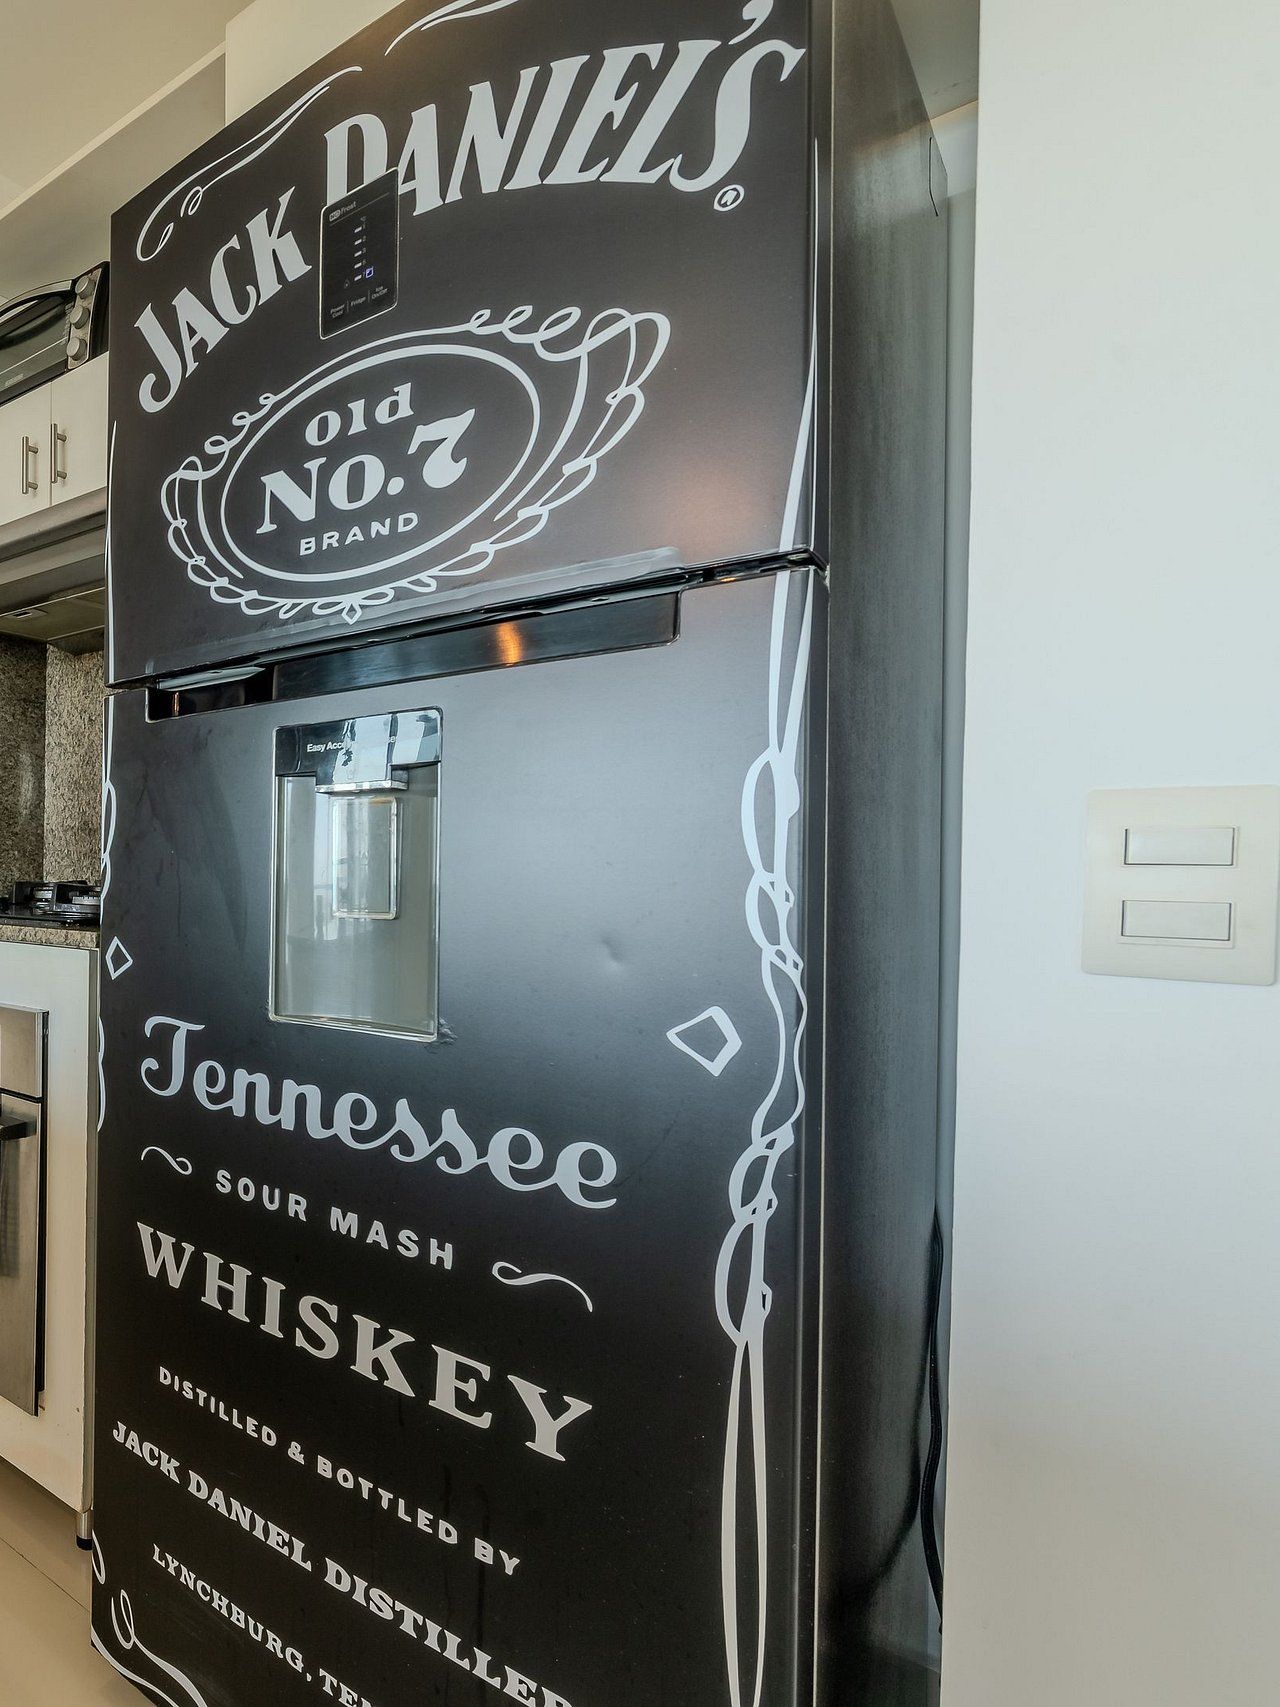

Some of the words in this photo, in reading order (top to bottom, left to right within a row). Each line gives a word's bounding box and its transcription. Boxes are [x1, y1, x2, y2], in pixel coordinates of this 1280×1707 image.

[134, 186, 313, 413] JACK
[407, 408, 476, 489] 7
[299, 512, 419, 556] BRAND
[306, 743, 326, 753] Easy
[140, 1015, 617, 1209] Tennessee
[216, 1169, 308, 1222] SOUR
[329, 1206, 453, 1270] MASH
[136, 1221, 593, 1462] WHISKEY
[112, 1420, 180, 1484] JACK
[187, 1469, 312, 1572] DANIEL
[159, 1366, 277, 1447] DISTILLED
[287, 1441, 305, 1464] &
[317, 1454, 458, 1545] BOTTLED
[474, 1537, 521, 1576] BY
[152, 1543, 312, 1682] LYNCHBURG,
[319, 1667, 372, 1707] TE
